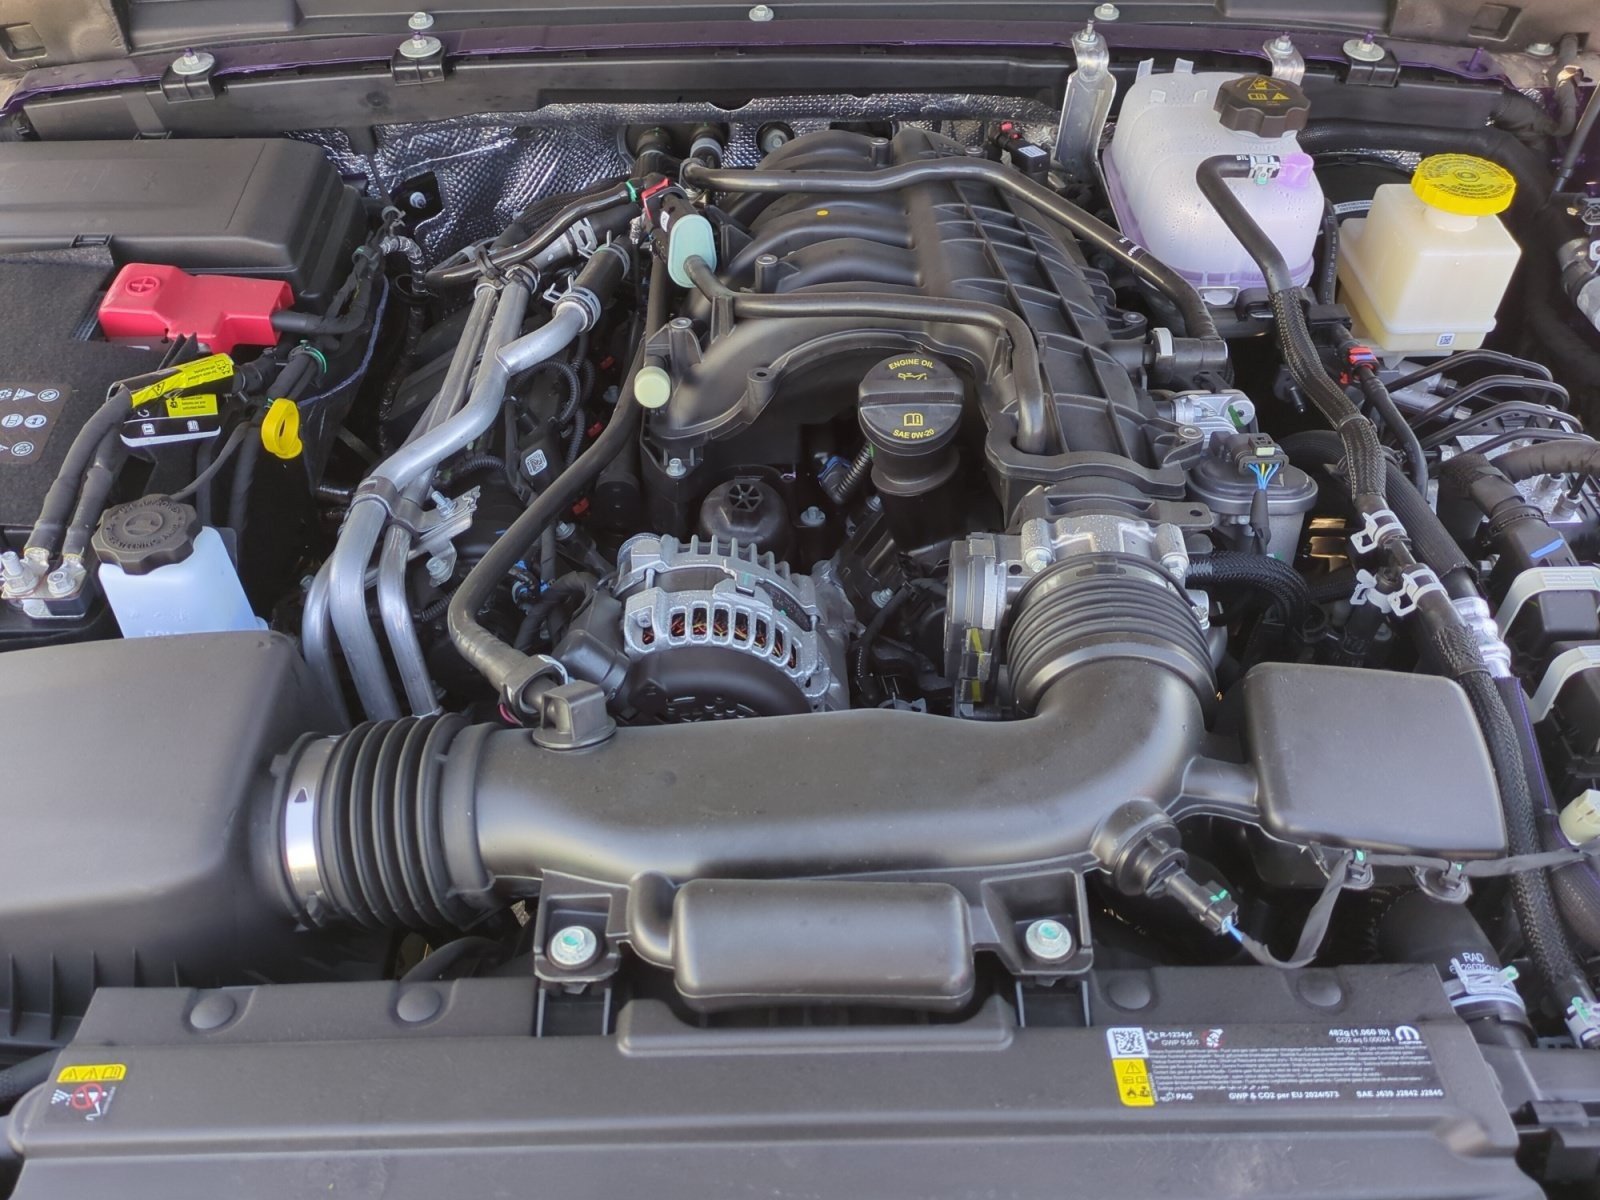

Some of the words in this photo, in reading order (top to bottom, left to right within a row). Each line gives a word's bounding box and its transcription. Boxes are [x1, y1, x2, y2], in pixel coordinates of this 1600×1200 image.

[888, 358, 920, 370] ENGINE
[922, 359, 934, 369] OIL
[892, 428, 910, 438] SAE
[911, 428, 935, 439] 0W-20
[1462, 952, 1484, 963] RAD
